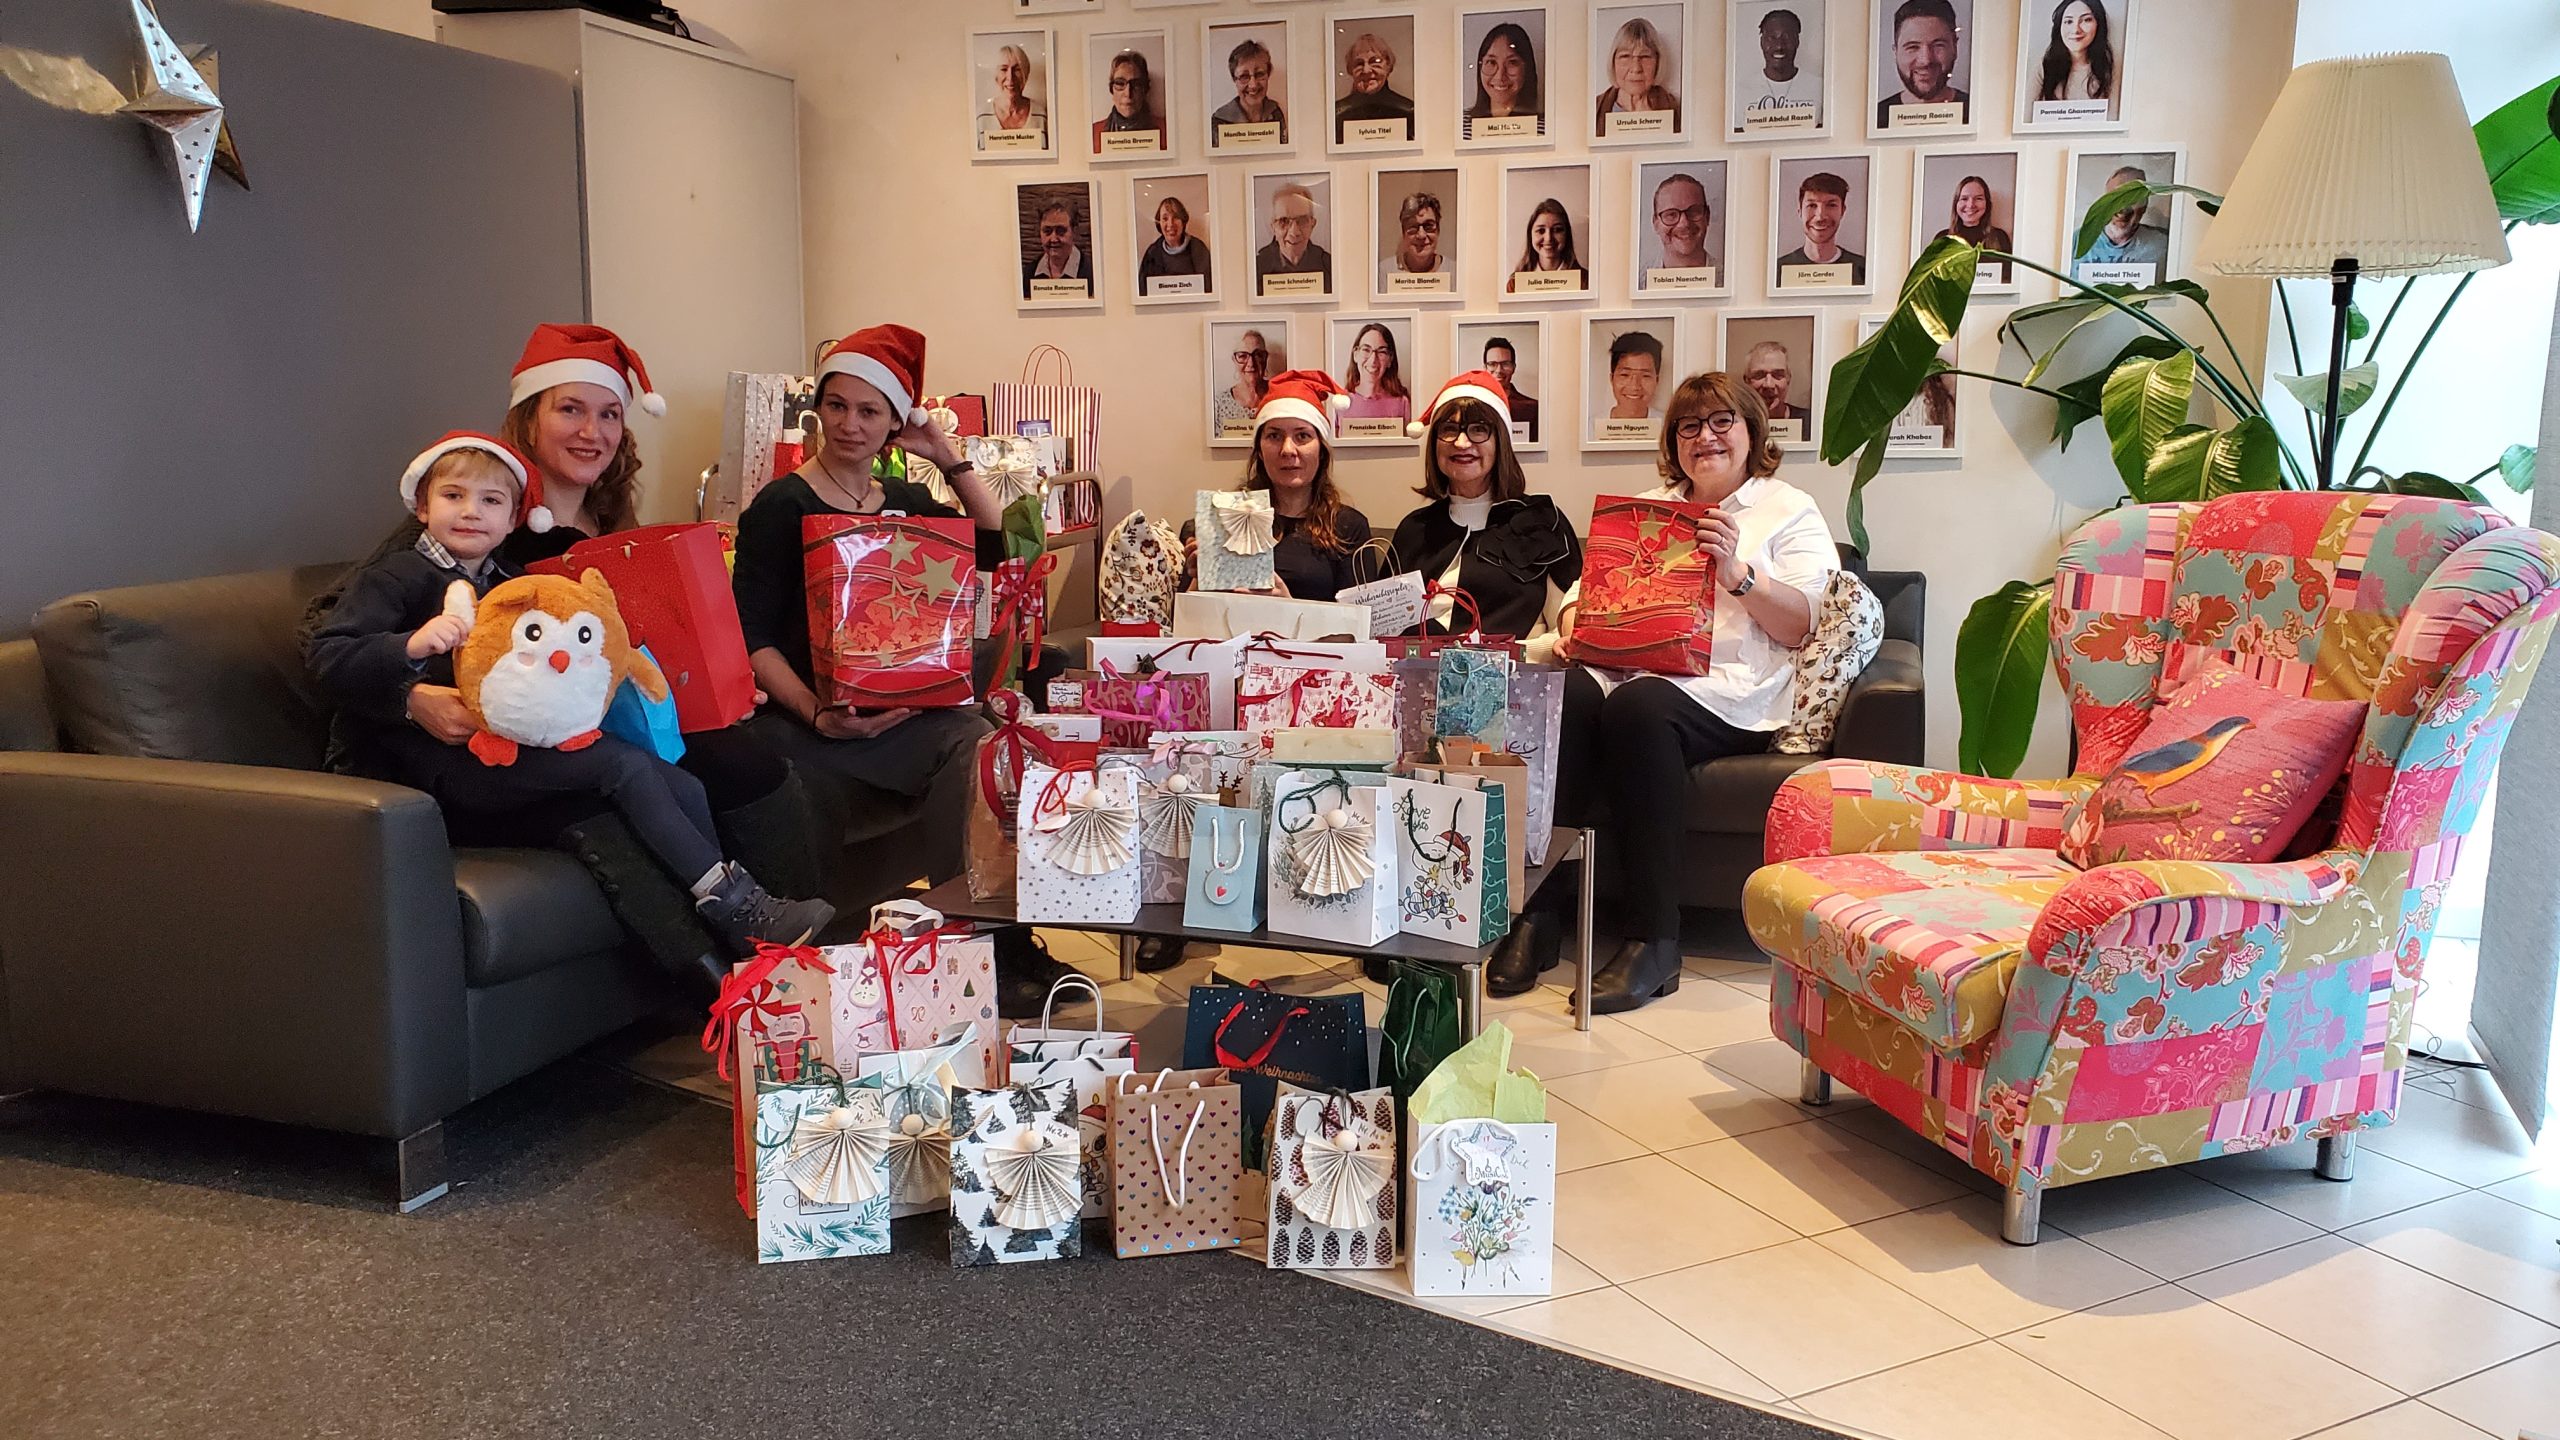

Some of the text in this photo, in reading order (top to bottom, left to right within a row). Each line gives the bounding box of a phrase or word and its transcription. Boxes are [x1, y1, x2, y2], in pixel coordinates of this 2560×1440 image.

[1638, 117, 1662, 125] Scherer
[1769, 115, 1790, 123] Abdul
[1897, 113, 1927, 121] Henning
[1358, 128, 1377, 136] Sylvia
[1624, 425, 1650, 433] Nguyen
